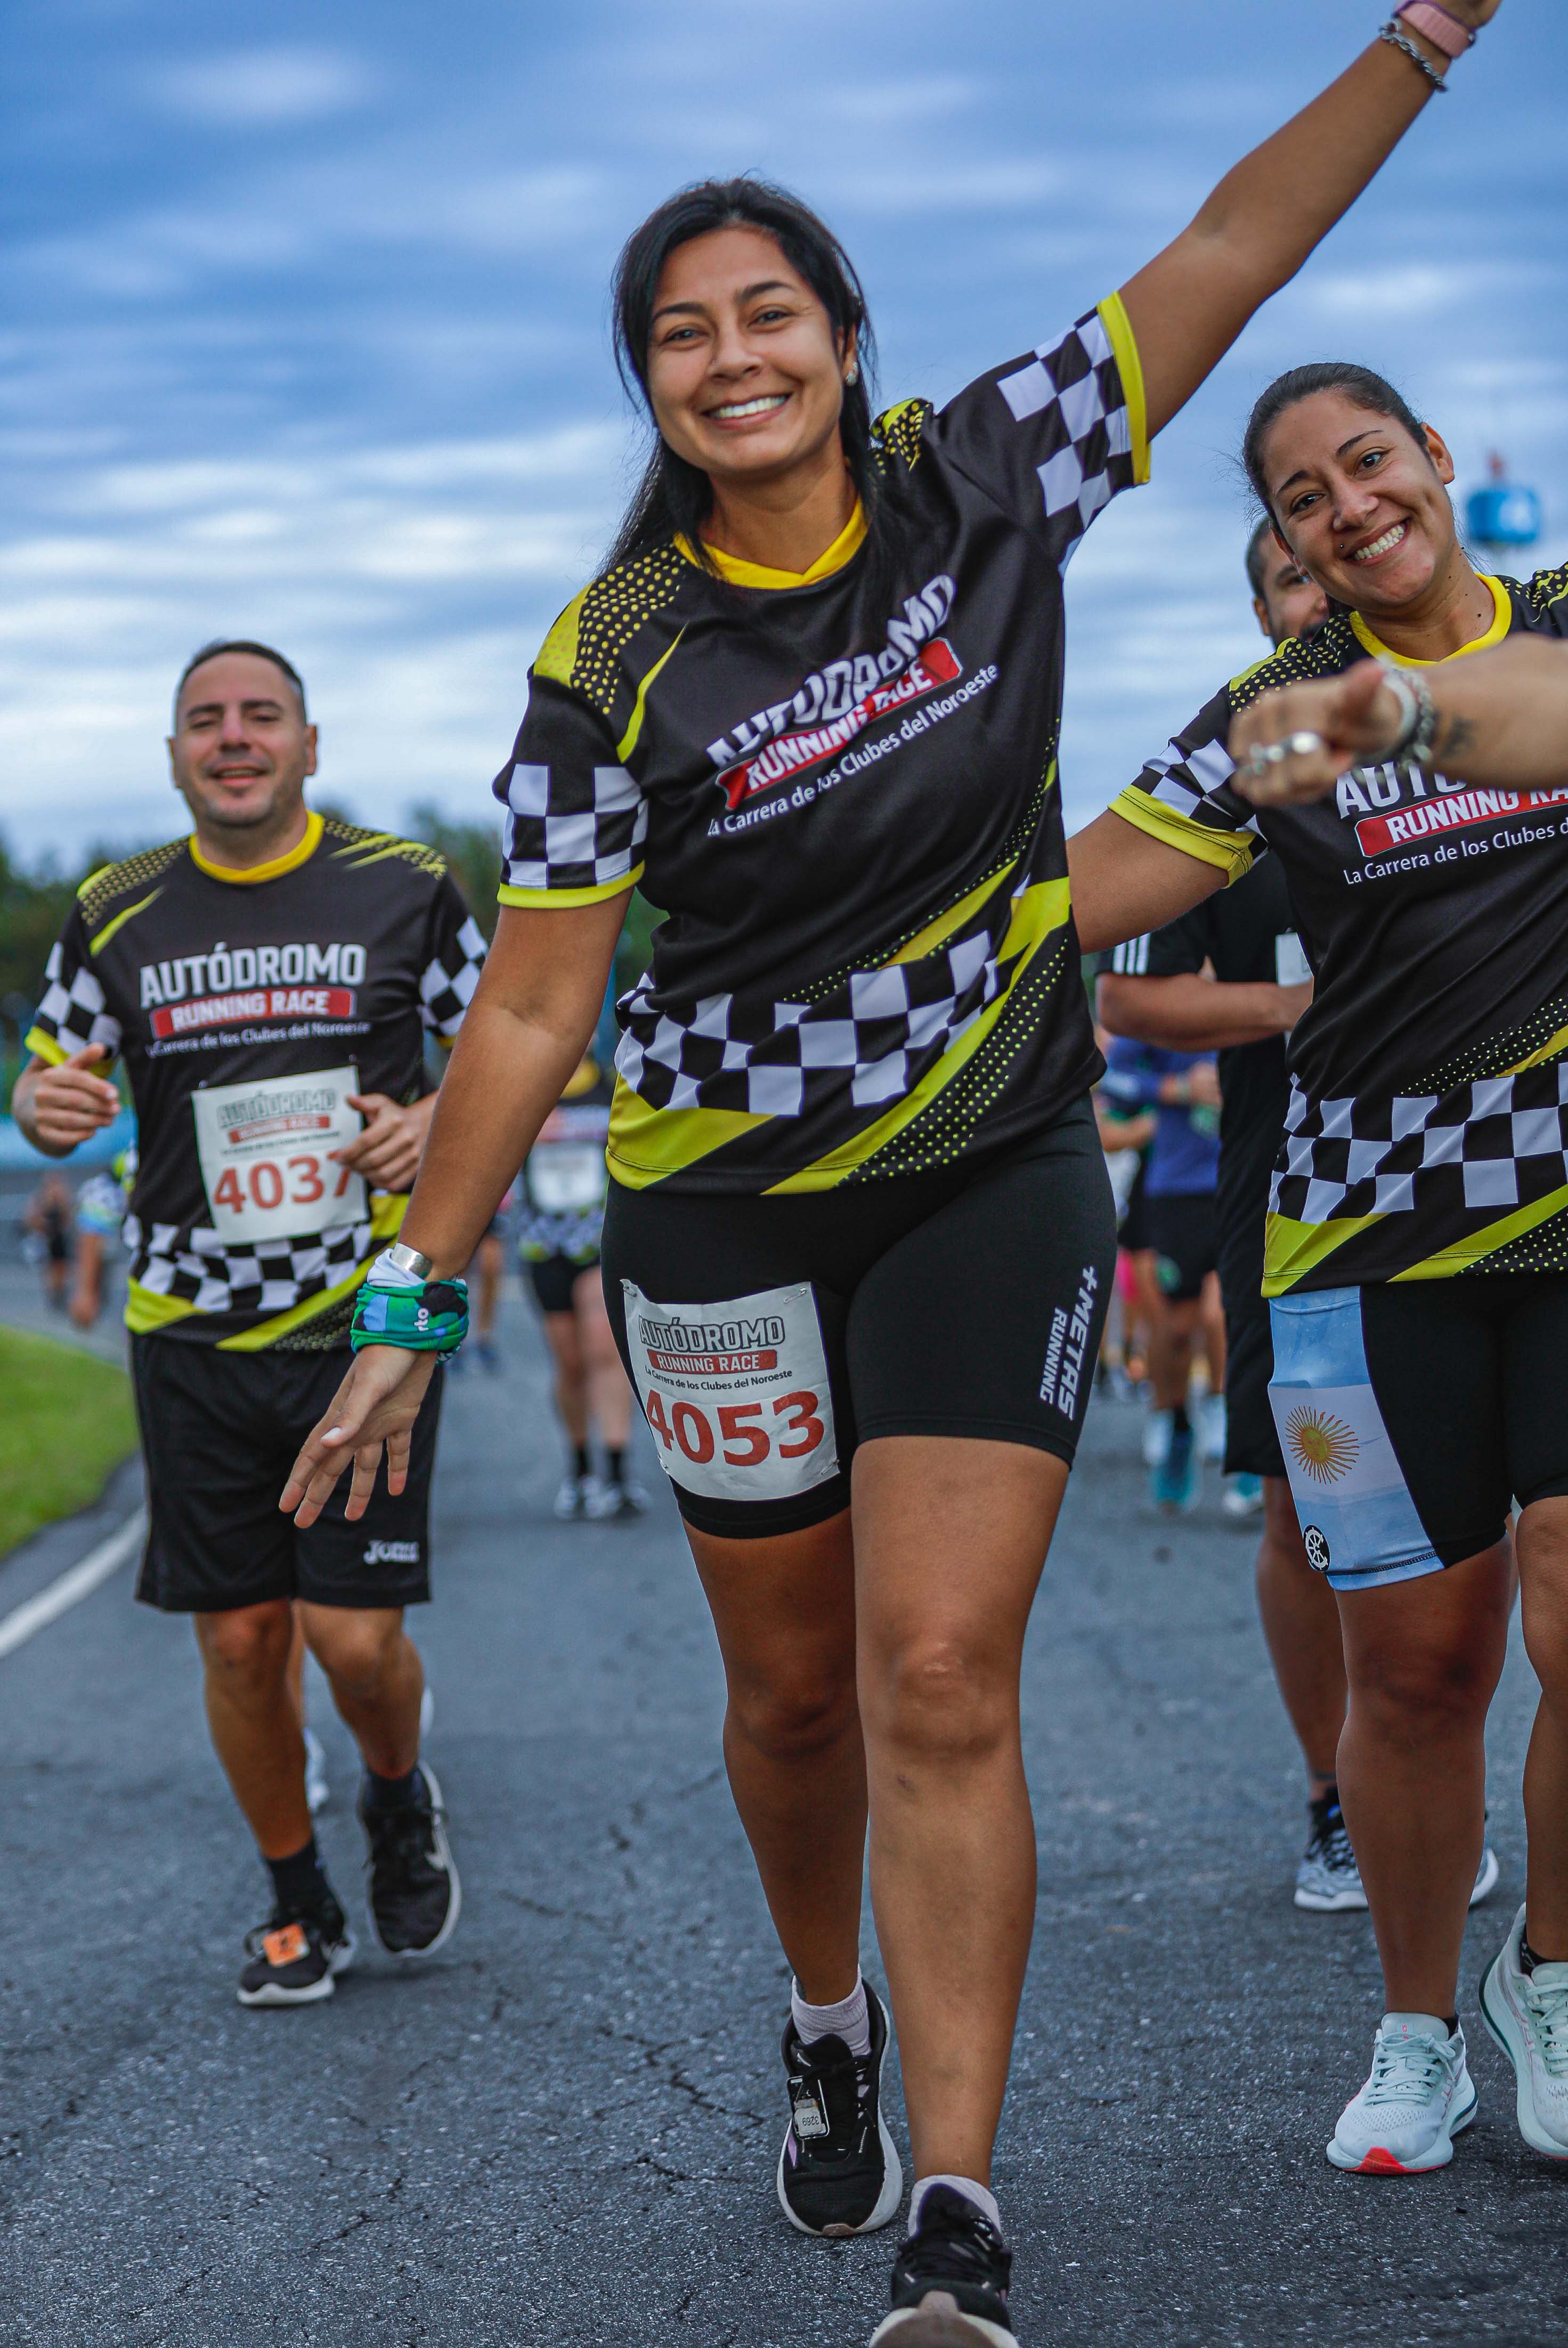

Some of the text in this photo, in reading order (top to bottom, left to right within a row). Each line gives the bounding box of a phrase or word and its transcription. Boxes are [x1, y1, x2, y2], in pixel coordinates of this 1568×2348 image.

[725, 798, 789, 832] Carrera
[792, 786, 816, 807] de
[817, 769, 841, 792] los
[840, 733, 901, 775] Clubes
[900, 710, 930, 741] del
[925, 665, 997, 722] Noroeste
[747, 704, 870, 790] RUNNING
[1386, 787, 1519, 843] RUNNING
[1343, 826, 1555, 885] La Carrera de los Clubes
[140, 941, 367, 1010] AUTÓDROMO
[170, 990, 329, 1032] RUNNING RACE
[200, 1033, 218, 1050] de
[241, 1026, 287, 1045] Clubes
[288, 1022, 311, 1039] del
[639, 1315, 786, 1352] AUTÓDROMO
[1040, 1306, 1068, 1405] RUNNING
[645, 1365, 793, 1391] La Carrera de los Clubes del Noroeste
[656, 1354, 760, 1372] RUNNING RACE
[646, 1389, 824, 1466] 4053
